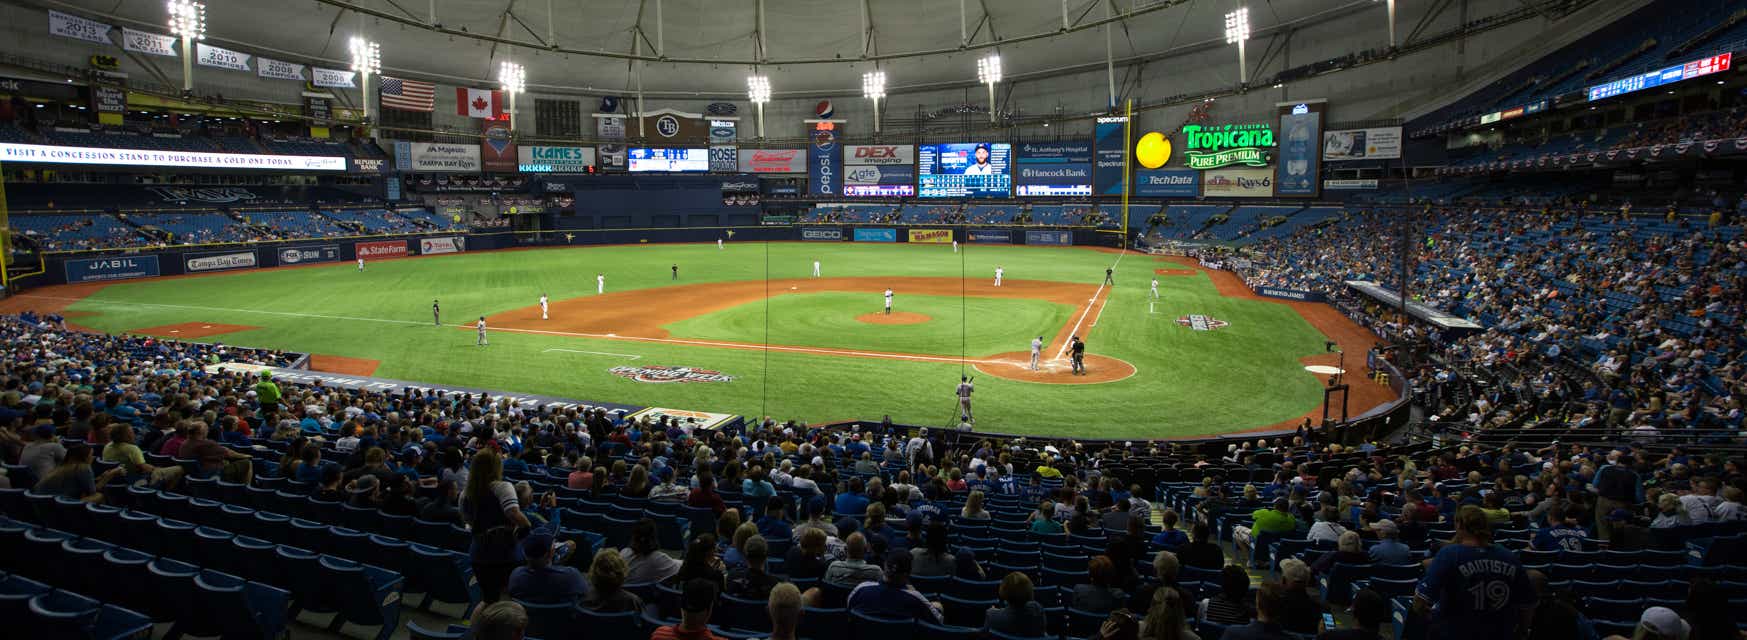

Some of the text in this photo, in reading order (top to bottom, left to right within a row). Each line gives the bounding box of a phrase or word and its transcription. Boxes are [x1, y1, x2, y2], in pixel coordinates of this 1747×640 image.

[65, 22, 97, 35] 2013
[137, 37, 163, 48] 2011
[210, 52, 237, 64] 2010
[201, 58, 246, 71] CHAMPIONS
[268, 64, 293, 74] 2008
[1182, 125, 1273, 152] Tropicana
[6, 148, 36, 158] VISIT
[40, 150, 47, 158] A
[50, 150, 116, 160] CONCESSION
[119, 152, 150, 161] STAND
[152, 154, 165, 162] TO
[168, 154, 213, 164] PURCHASE
[711, 148, 736, 160] ROSE
[854, 146, 897, 158] DEX
[1190, 151, 1260, 167] PURE PREMIUM
[821, 154, 833, 194] pepsi
[858, 168, 876, 180] gte
[1031, 168, 1087, 177] Hancock Bank
[1149, 176, 1193, 184] Tech Data
[1262, 176, 1270, 187] 6
[304, 250, 320, 260] SUN
[90, 260, 138, 270] JABIL
[191, 260, 216, 270] Tampa
[232, 257, 252, 266] Times
[1458, 559, 1516, 577] BAUTISTA
[1468, 580, 1510, 611] 19
